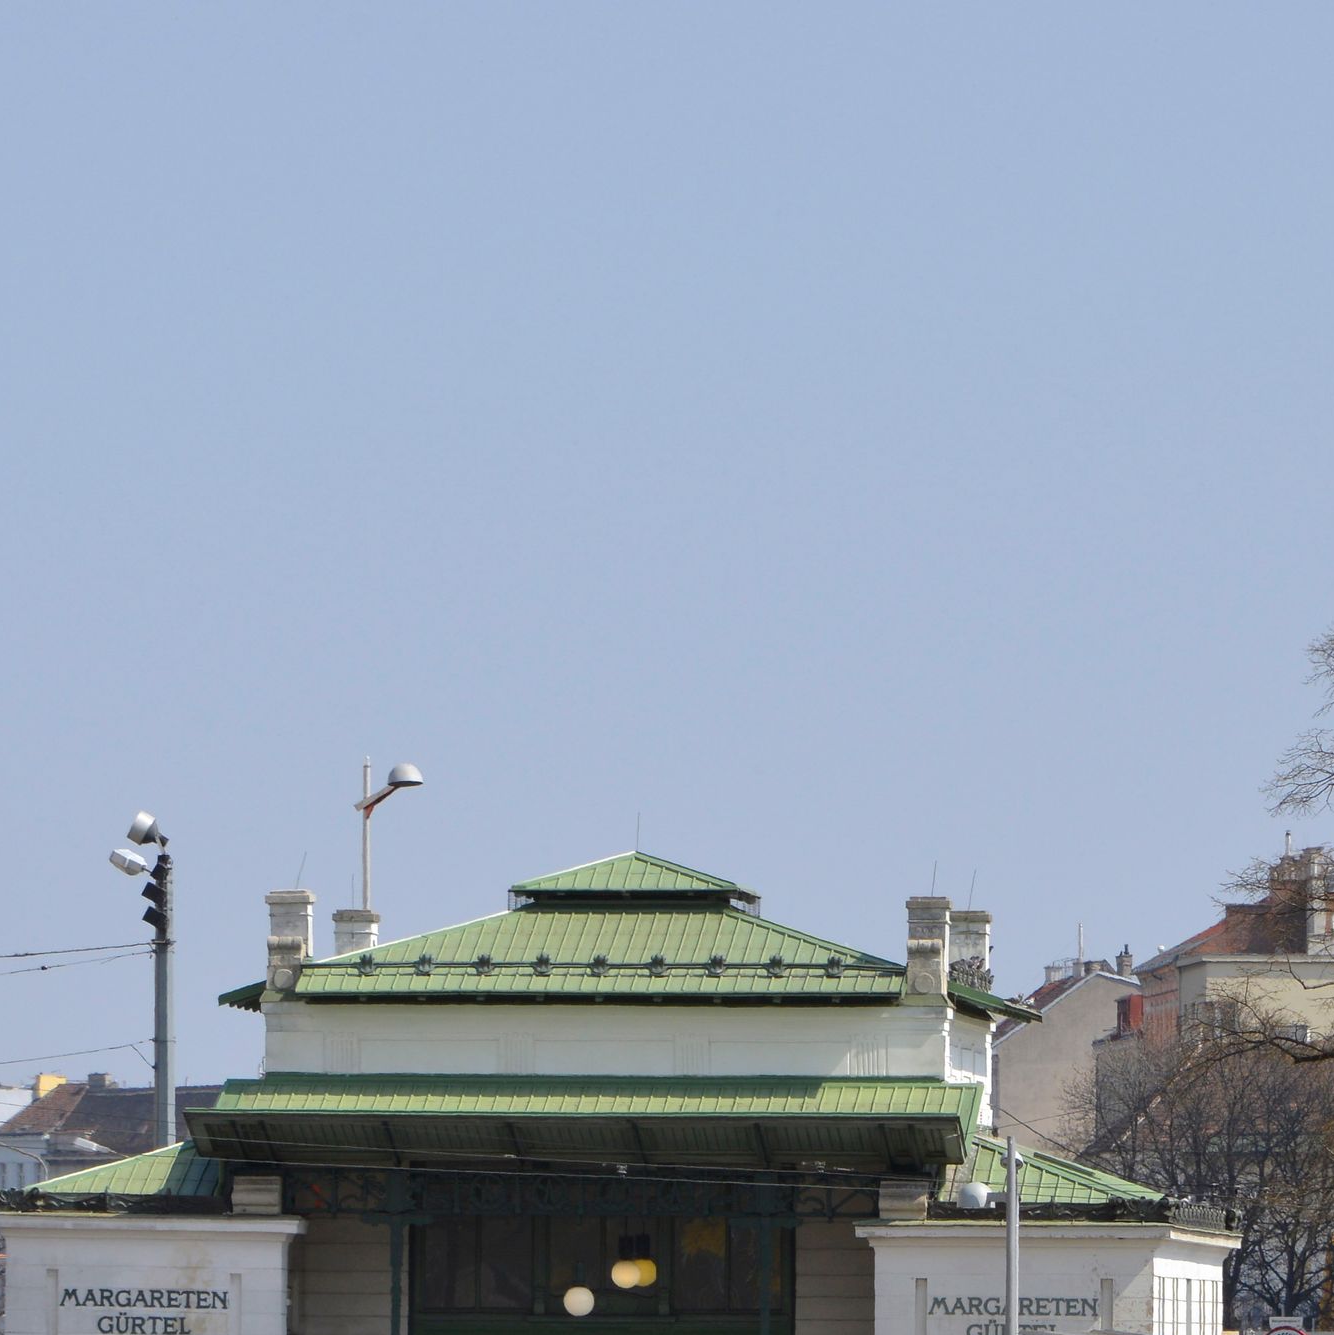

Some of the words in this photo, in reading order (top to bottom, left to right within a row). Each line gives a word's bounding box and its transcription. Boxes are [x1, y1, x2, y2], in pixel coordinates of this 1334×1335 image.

[59, 1288, 229, 1310] MARGARETEN
[928, 1296, 1099, 1317] MARGRETEN
[97, 1312, 191, 1335] GÜRTEL
